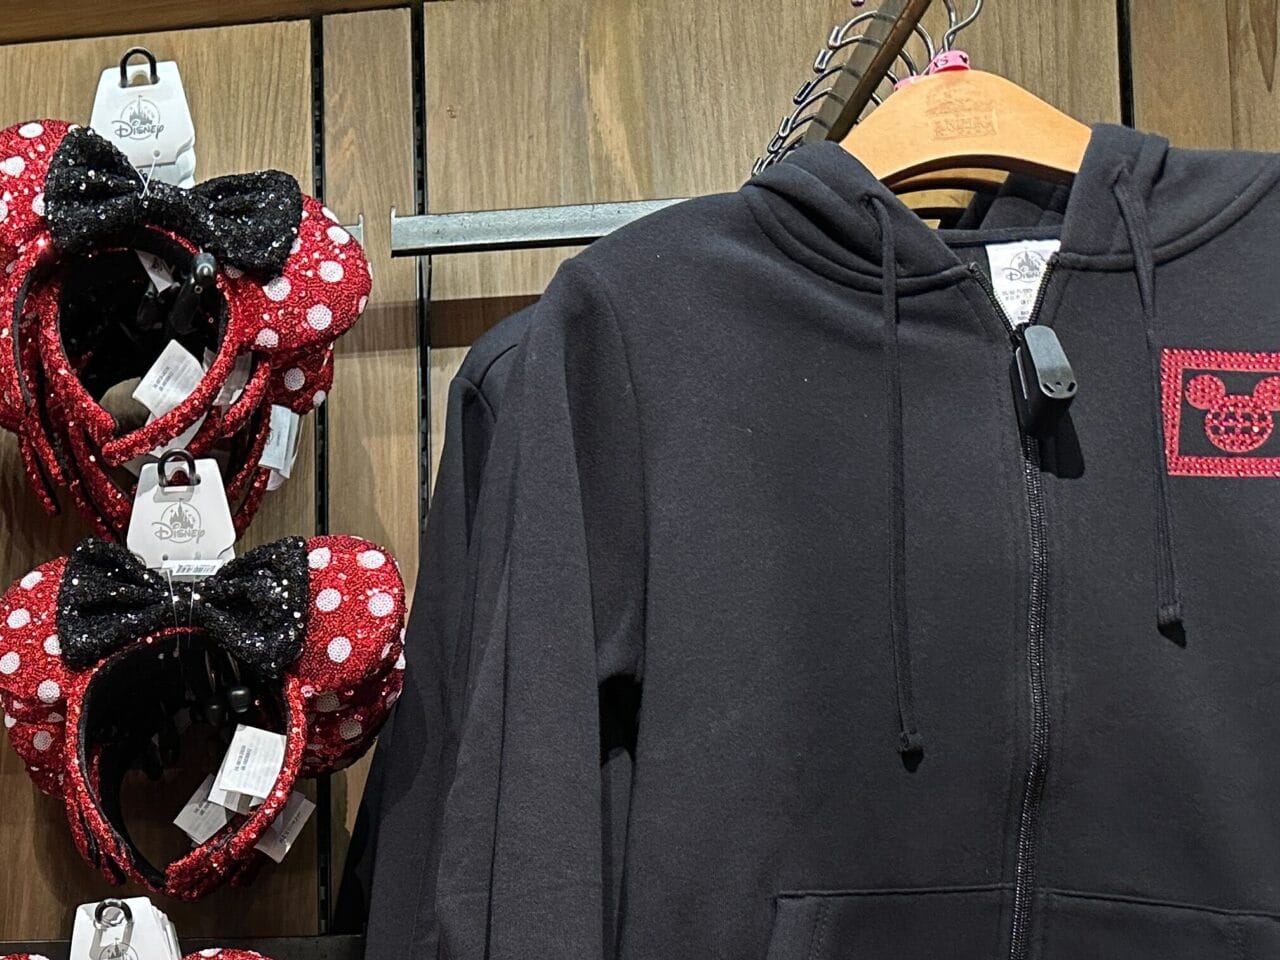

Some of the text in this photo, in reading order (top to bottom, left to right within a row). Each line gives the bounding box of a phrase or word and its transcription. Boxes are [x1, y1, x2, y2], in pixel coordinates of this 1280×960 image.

[111, 118, 165, 140] Disney
[1001, 266, 1041, 282] Disn
[151, 521, 206, 544] Disney
